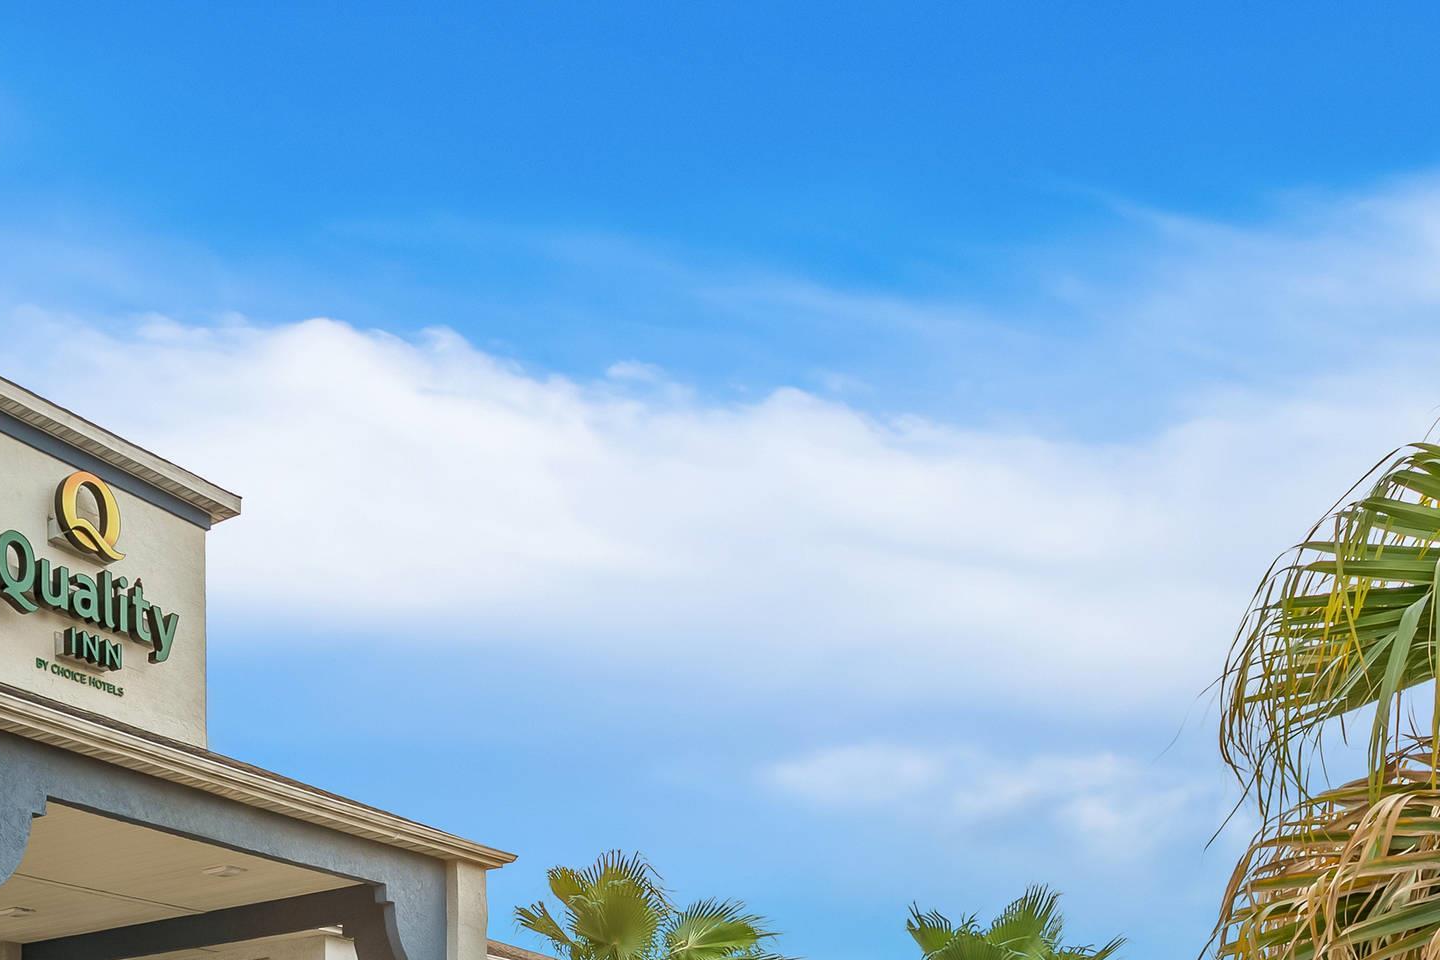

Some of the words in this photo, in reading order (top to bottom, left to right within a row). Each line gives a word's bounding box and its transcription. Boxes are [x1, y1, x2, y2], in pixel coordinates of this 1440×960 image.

[56, 471, 126, 564] Q
[64, 626, 122, 671] INN
[36, 657, 49, 671] BY
[51, 664, 87, 685] CHOICE
[88, 676, 124, 697] HOTELS
